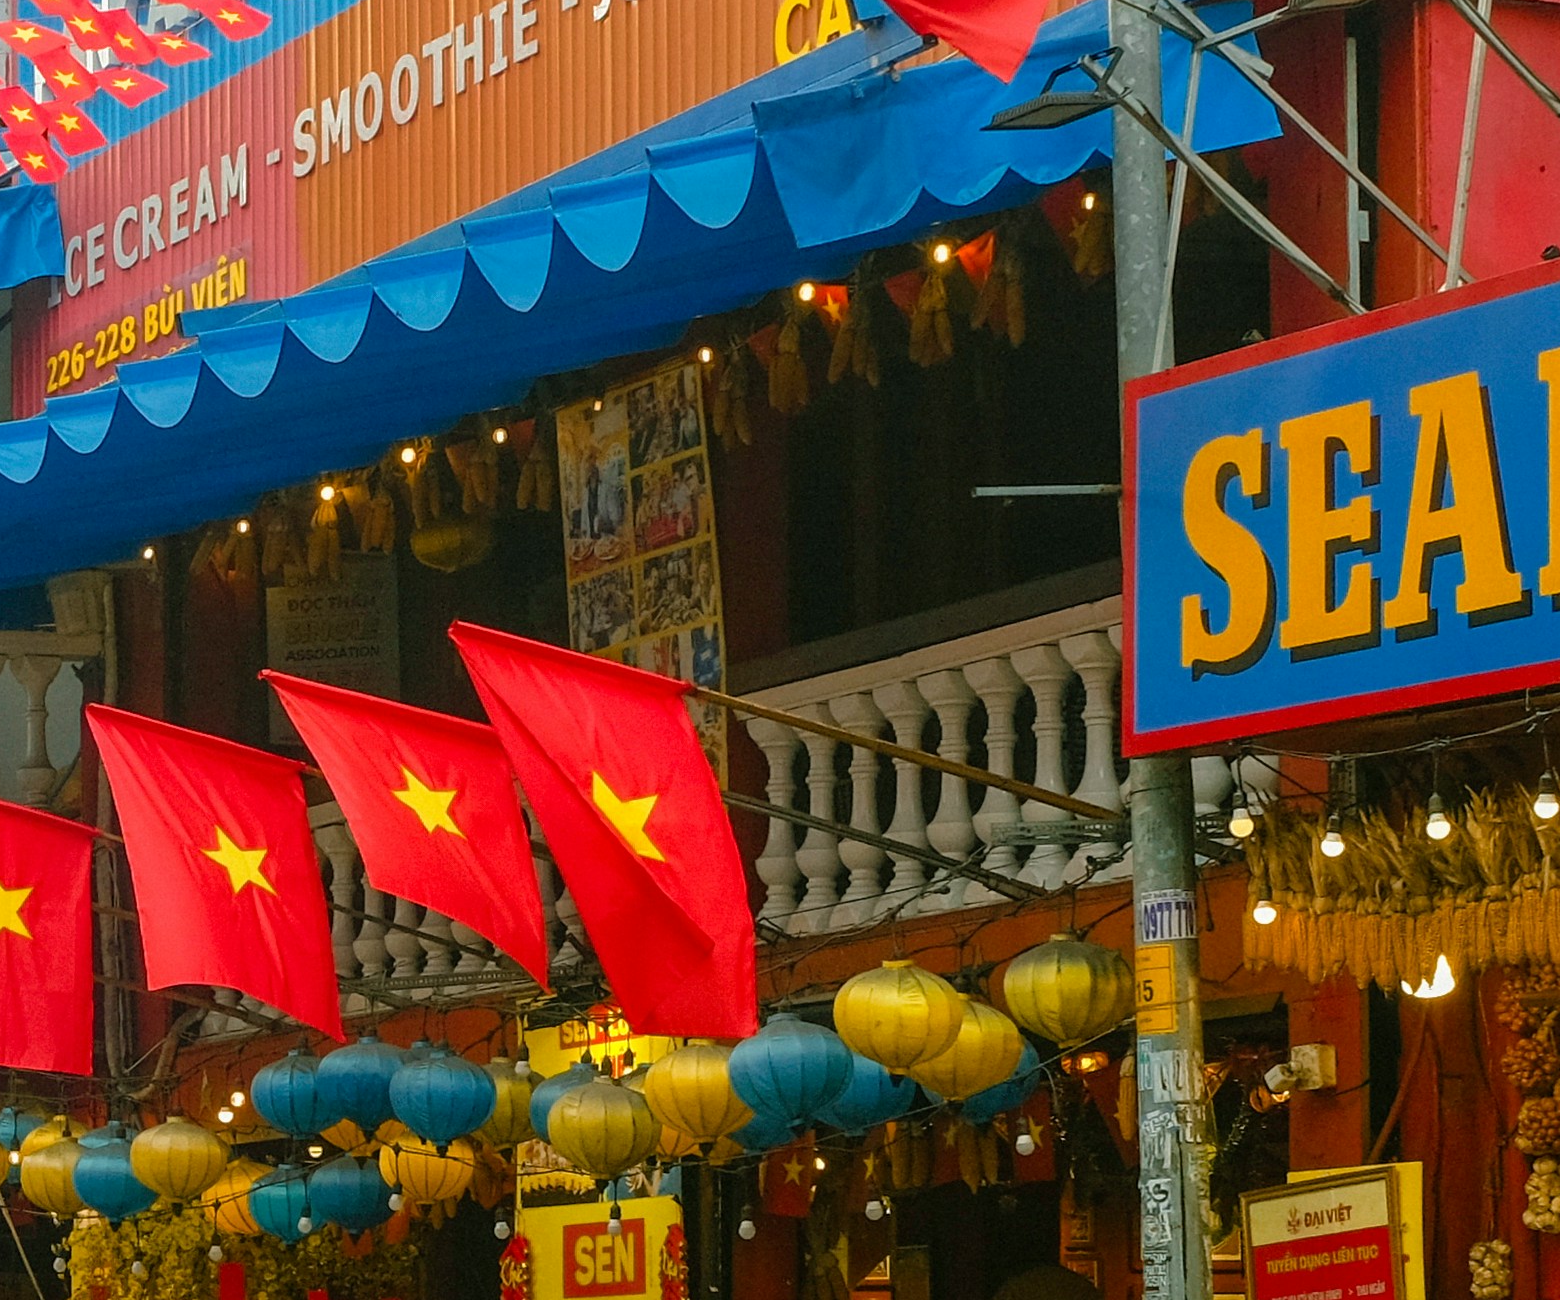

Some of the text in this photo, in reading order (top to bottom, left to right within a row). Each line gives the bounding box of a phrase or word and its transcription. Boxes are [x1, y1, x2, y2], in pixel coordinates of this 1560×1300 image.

[113, 144, 248, 270] CREAM
[46, 315, 137, 394] 226-228
[144, 284, 184, 344] BÙI
[285, 645, 380, 662] ASSOCIATION
[1304, 1202, 1353, 1230] ĐẠI VIỆT
[574, 1231, 635, 1287] SEN
[1266, 1249, 1298, 1275] TUYỂN
[1299, 1253, 1331, 1272] DỤNG
[1357, 1244, 1379, 1265] TỤC
